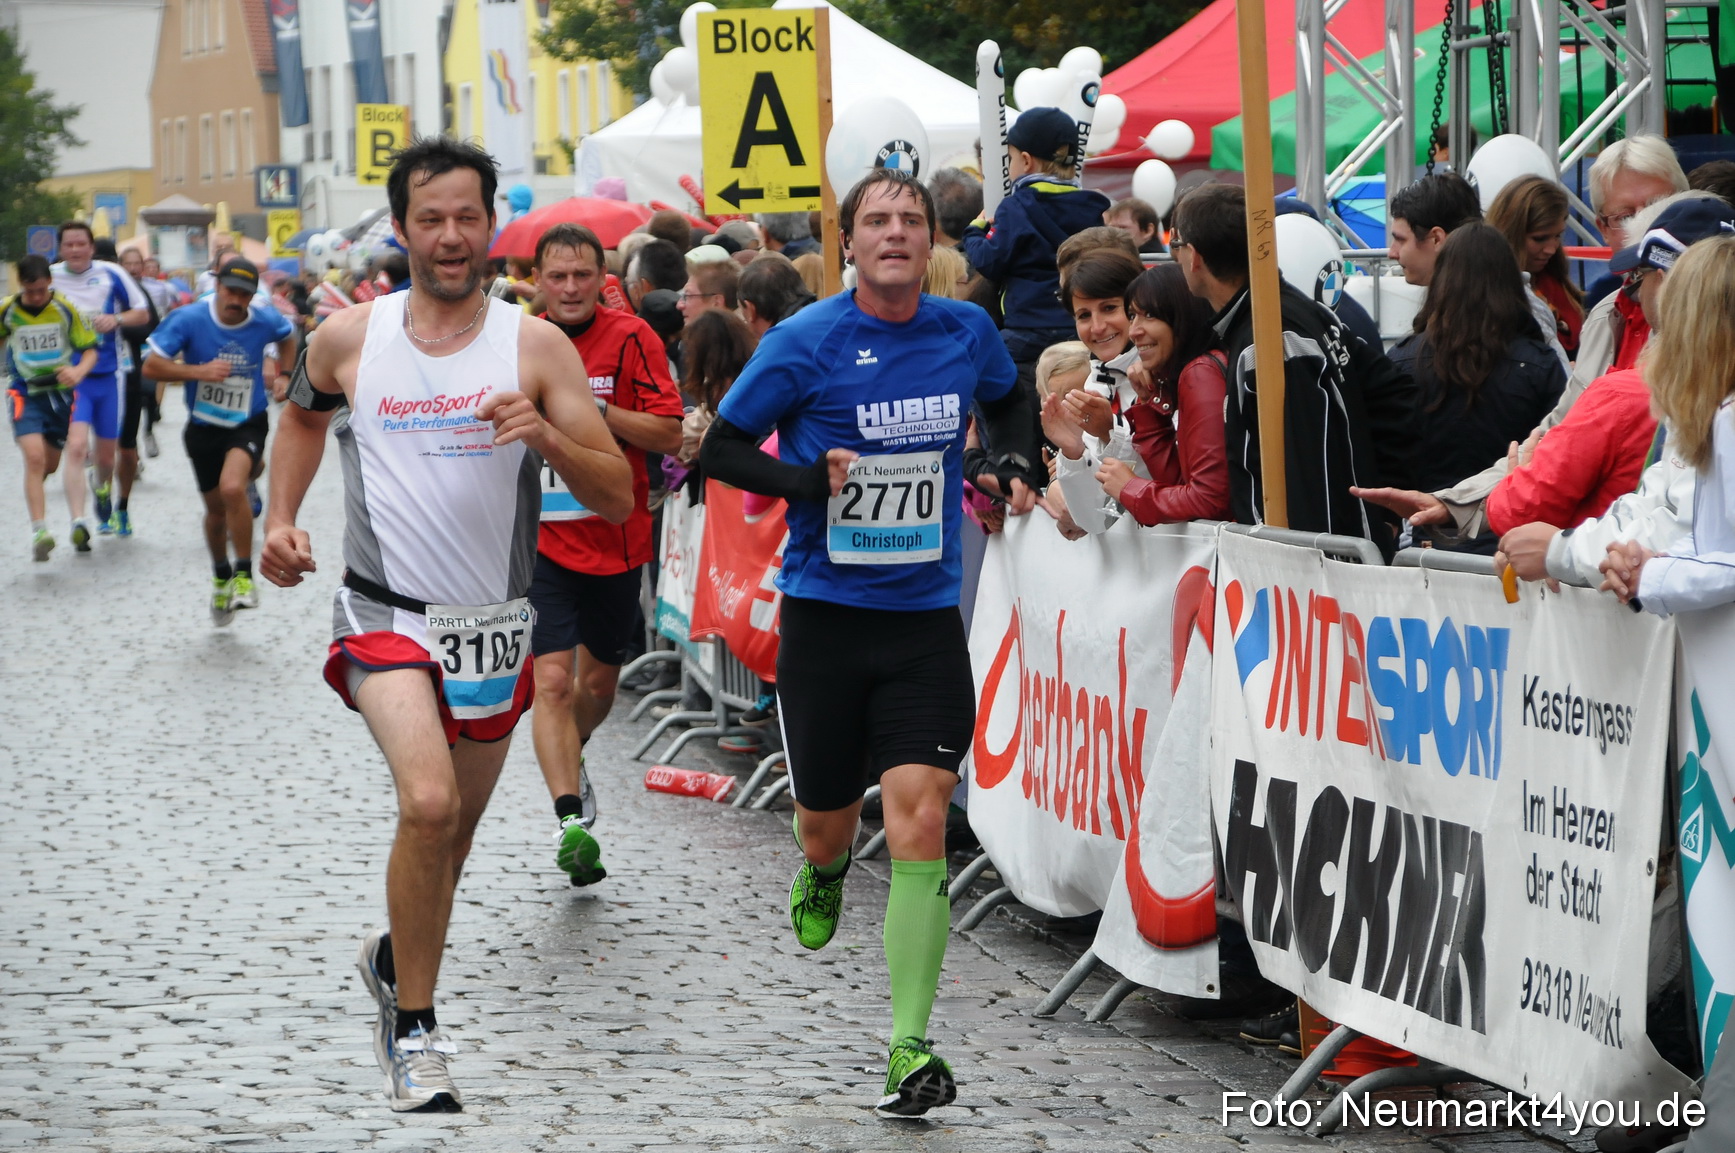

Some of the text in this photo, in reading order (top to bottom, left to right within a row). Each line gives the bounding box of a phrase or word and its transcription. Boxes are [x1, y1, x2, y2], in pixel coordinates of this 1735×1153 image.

[713, 17, 815, 53] Block
[362, 107, 404, 122] Block
[731, 71, 807, 168] A
[371, 129, 396, 167] B
[878, 140, 920, 161] BMW
[20, 334, 58, 352] 3125
[856, 357, 878, 365] erima
[202, 384, 244, 409] 3011
[383, 412, 479, 431] Pure Performance
[857, 393, 960, 428] HUBER
[882, 420, 957, 436] TECHNOLOGY
[883, 432, 956, 446] WASTE WATER Solutions
[874, 465, 927, 476] Neumarkt
[840, 480, 934, 521] 2770
[832, 517, 838, 525] B
[852, 532, 922, 551] Christoph
[429, 612, 518, 628] PARTL Neumarkt
[439, 629, 524, 675] 3105
[1265, 584, 1510, 781] INTERSPORT
[1523, 674, 1637, 756] Kastengass
[1523, 779, 1616, 854] Im Herzen
[1526, 852, 1602, 925] der Stadt
[1521, 956, 1572, 1025] 92318
